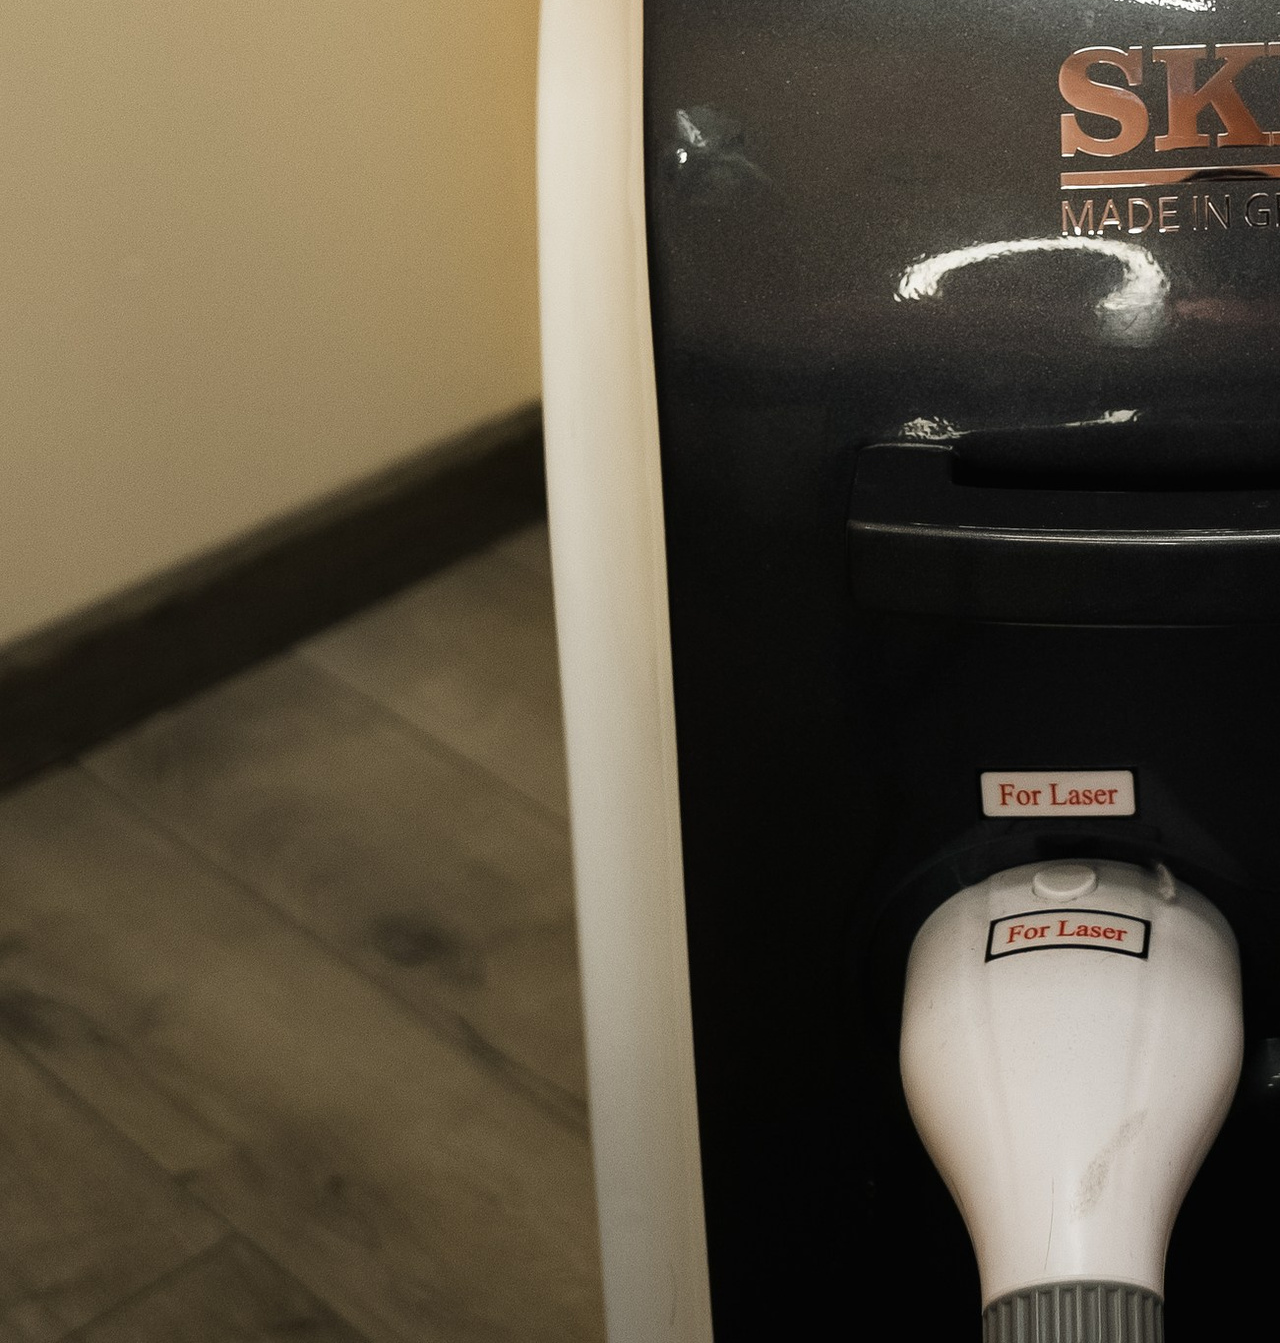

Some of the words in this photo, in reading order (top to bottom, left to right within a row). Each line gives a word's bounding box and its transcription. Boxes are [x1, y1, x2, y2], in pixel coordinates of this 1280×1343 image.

[1061, 195, 1180, 236] MADE
[1192, 194, 1232, 231] IN
[999, 783, 1041, 806] For
[1049, 783, 1118, 805] Laser
[1006, 924, 1050, 944] For
[1056, 920, 1127, 942] Laser
